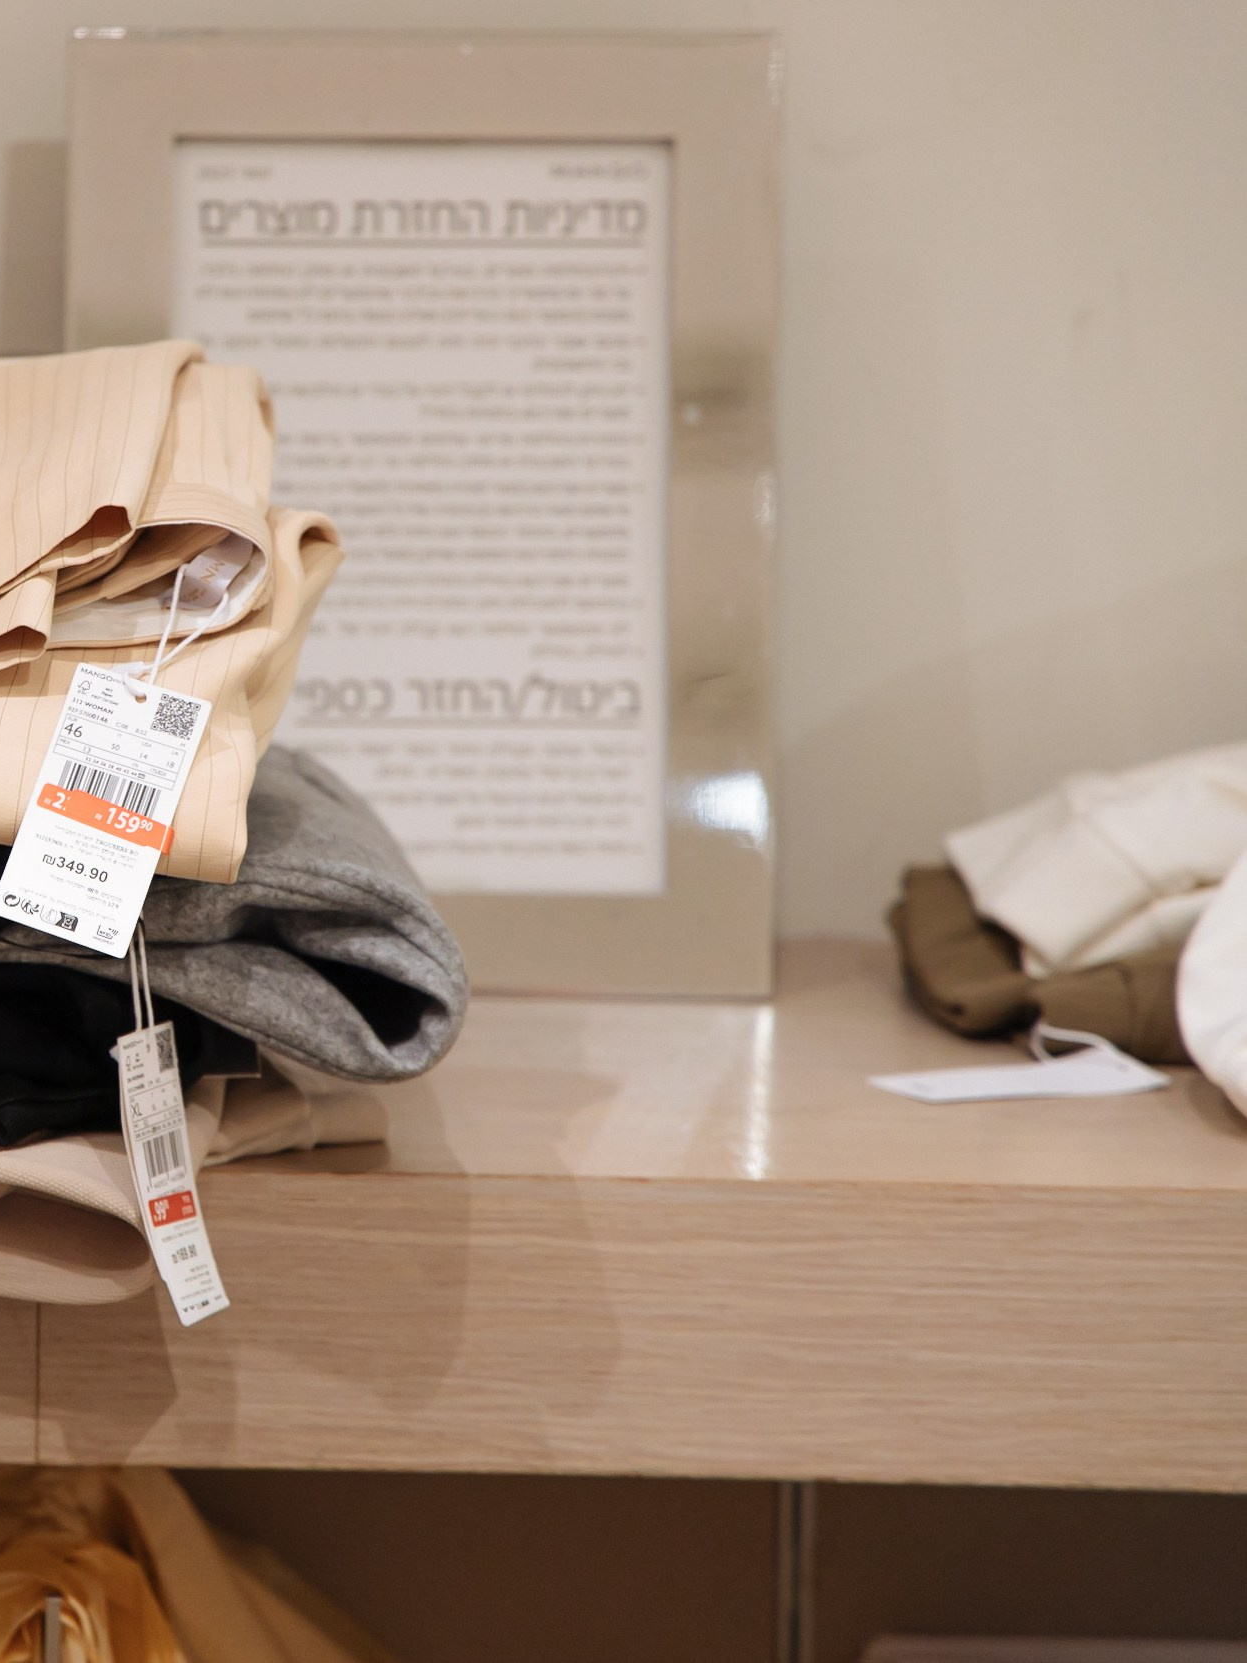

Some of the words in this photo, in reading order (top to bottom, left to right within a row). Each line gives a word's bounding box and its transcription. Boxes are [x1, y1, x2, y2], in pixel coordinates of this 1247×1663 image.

[199, 198, 339, 236] מוצרים
[351, 198, 491, 236] החזרת
[80, 667, 113, 681] MANGO
[84, 701, 113, 714] WOMAN
[63, 723, 82, 737] 46
[51, 791, 70, 811] 2
